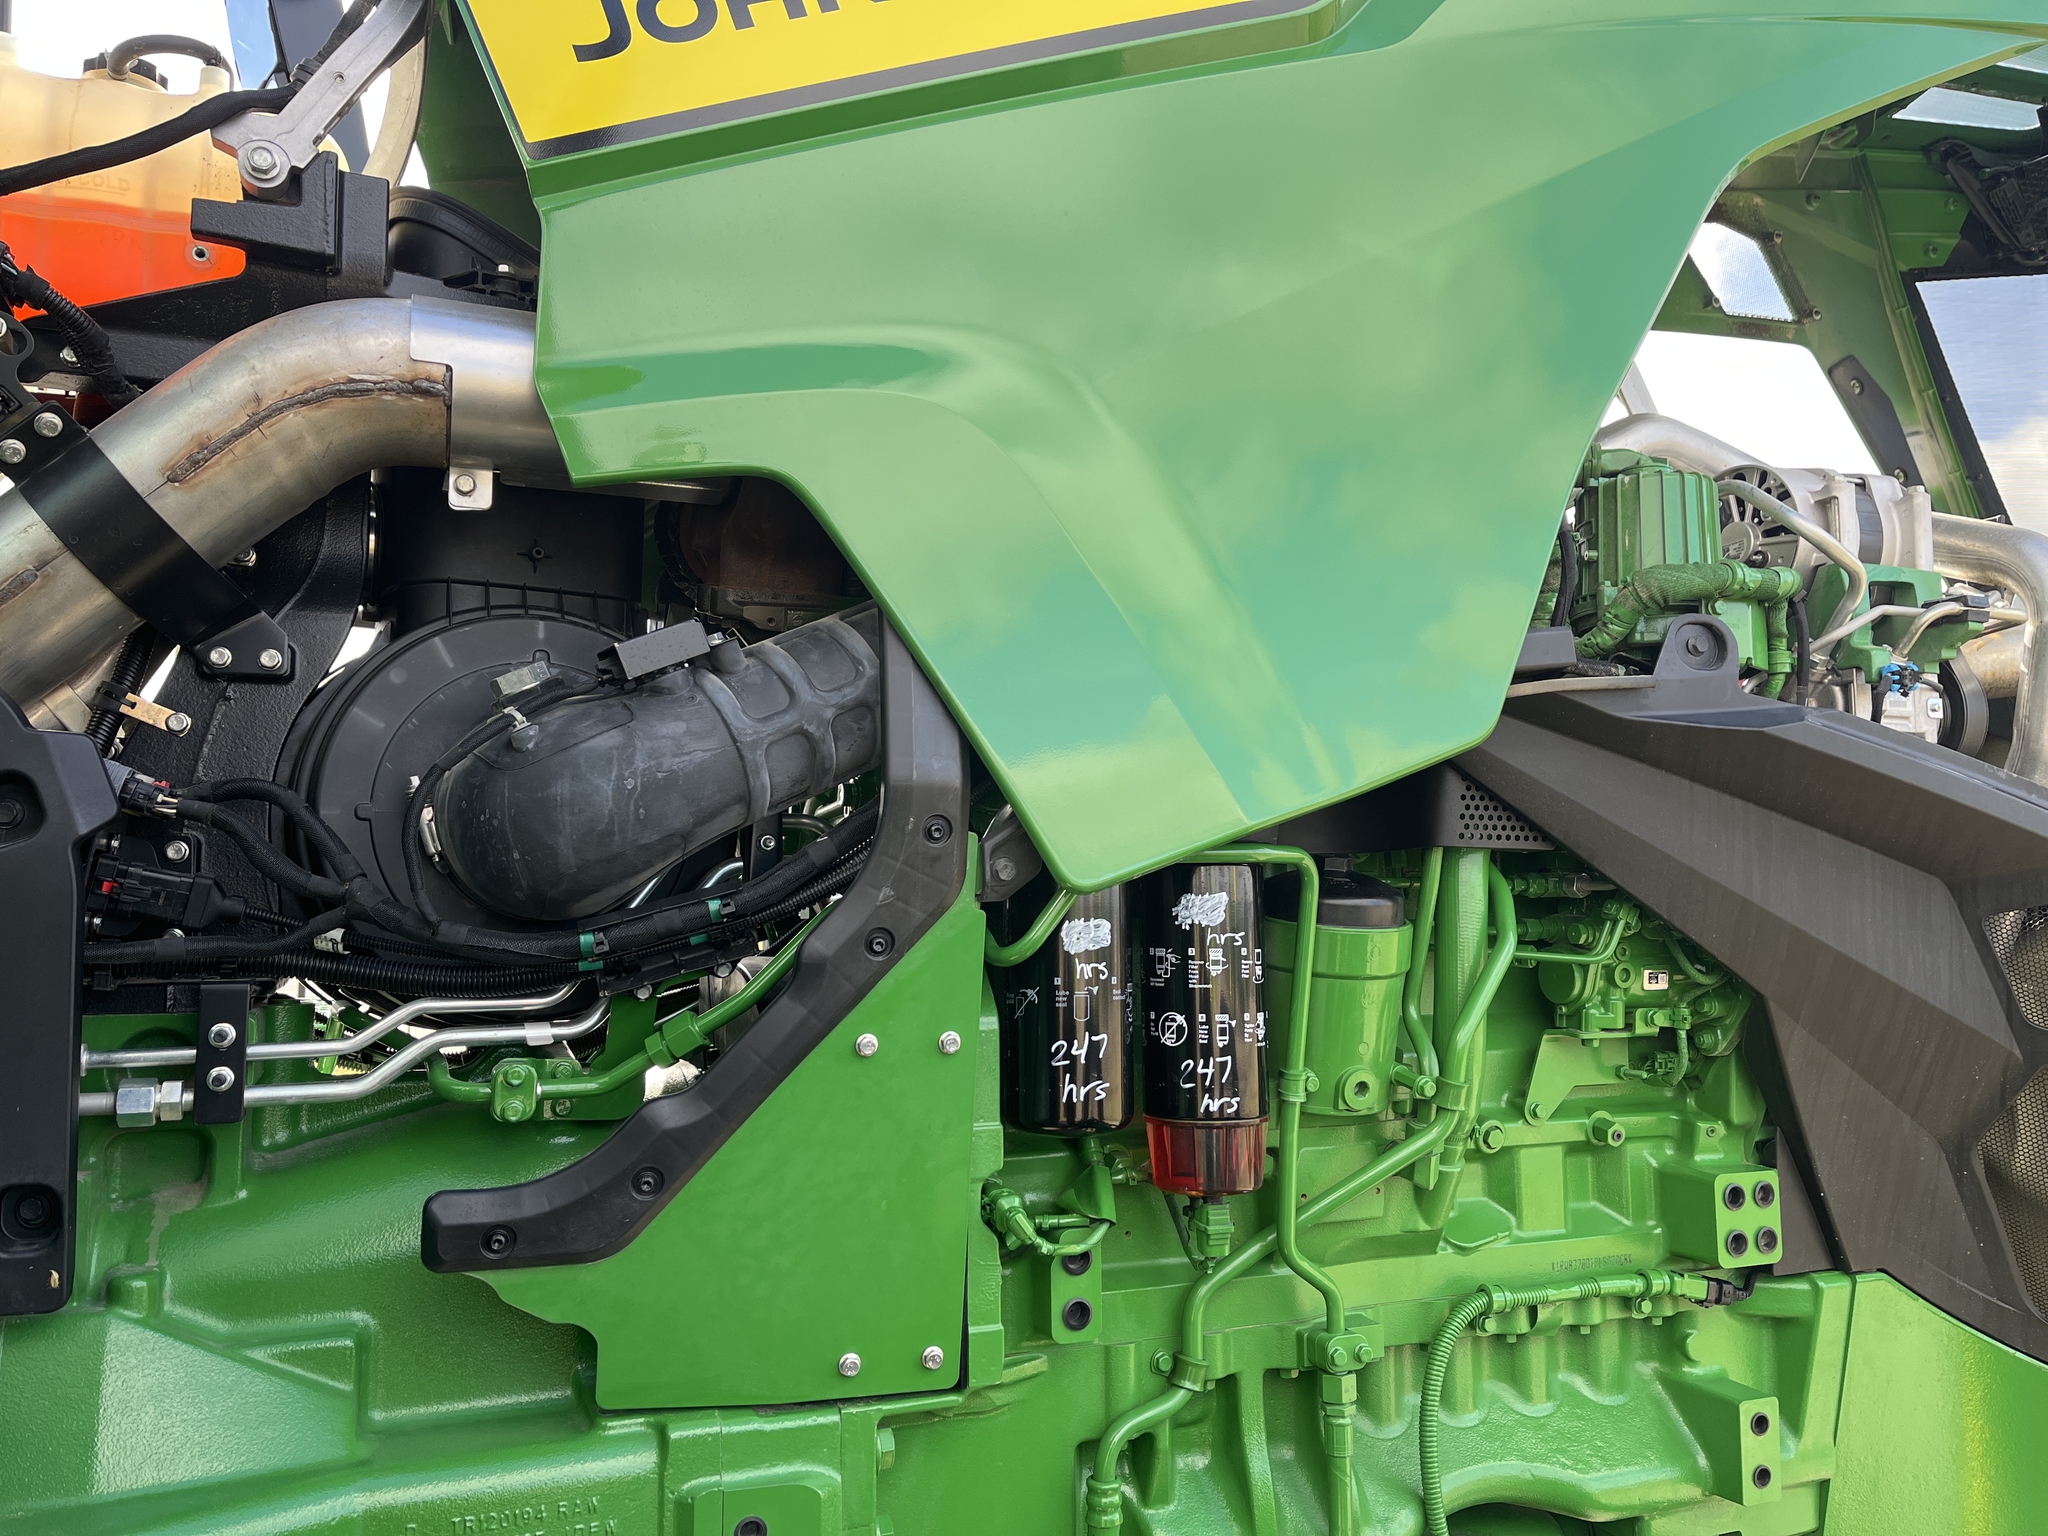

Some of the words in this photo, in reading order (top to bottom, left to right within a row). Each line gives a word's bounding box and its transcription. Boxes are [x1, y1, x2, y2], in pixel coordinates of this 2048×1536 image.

[572, 0, 888, 63] JO
[1206, 927, 1245, 946] hrs
[1075, 957, 1108, 980] hrs
[1051, 1031, 1108, 1067] 247
[1179, 1055, 1232, 1089] 247
[1062, 1073, 1110, 1104] hrs
[1200, 1093, 1241, 1114] hrs
[450, 1504, 547, 1534] TR120194
